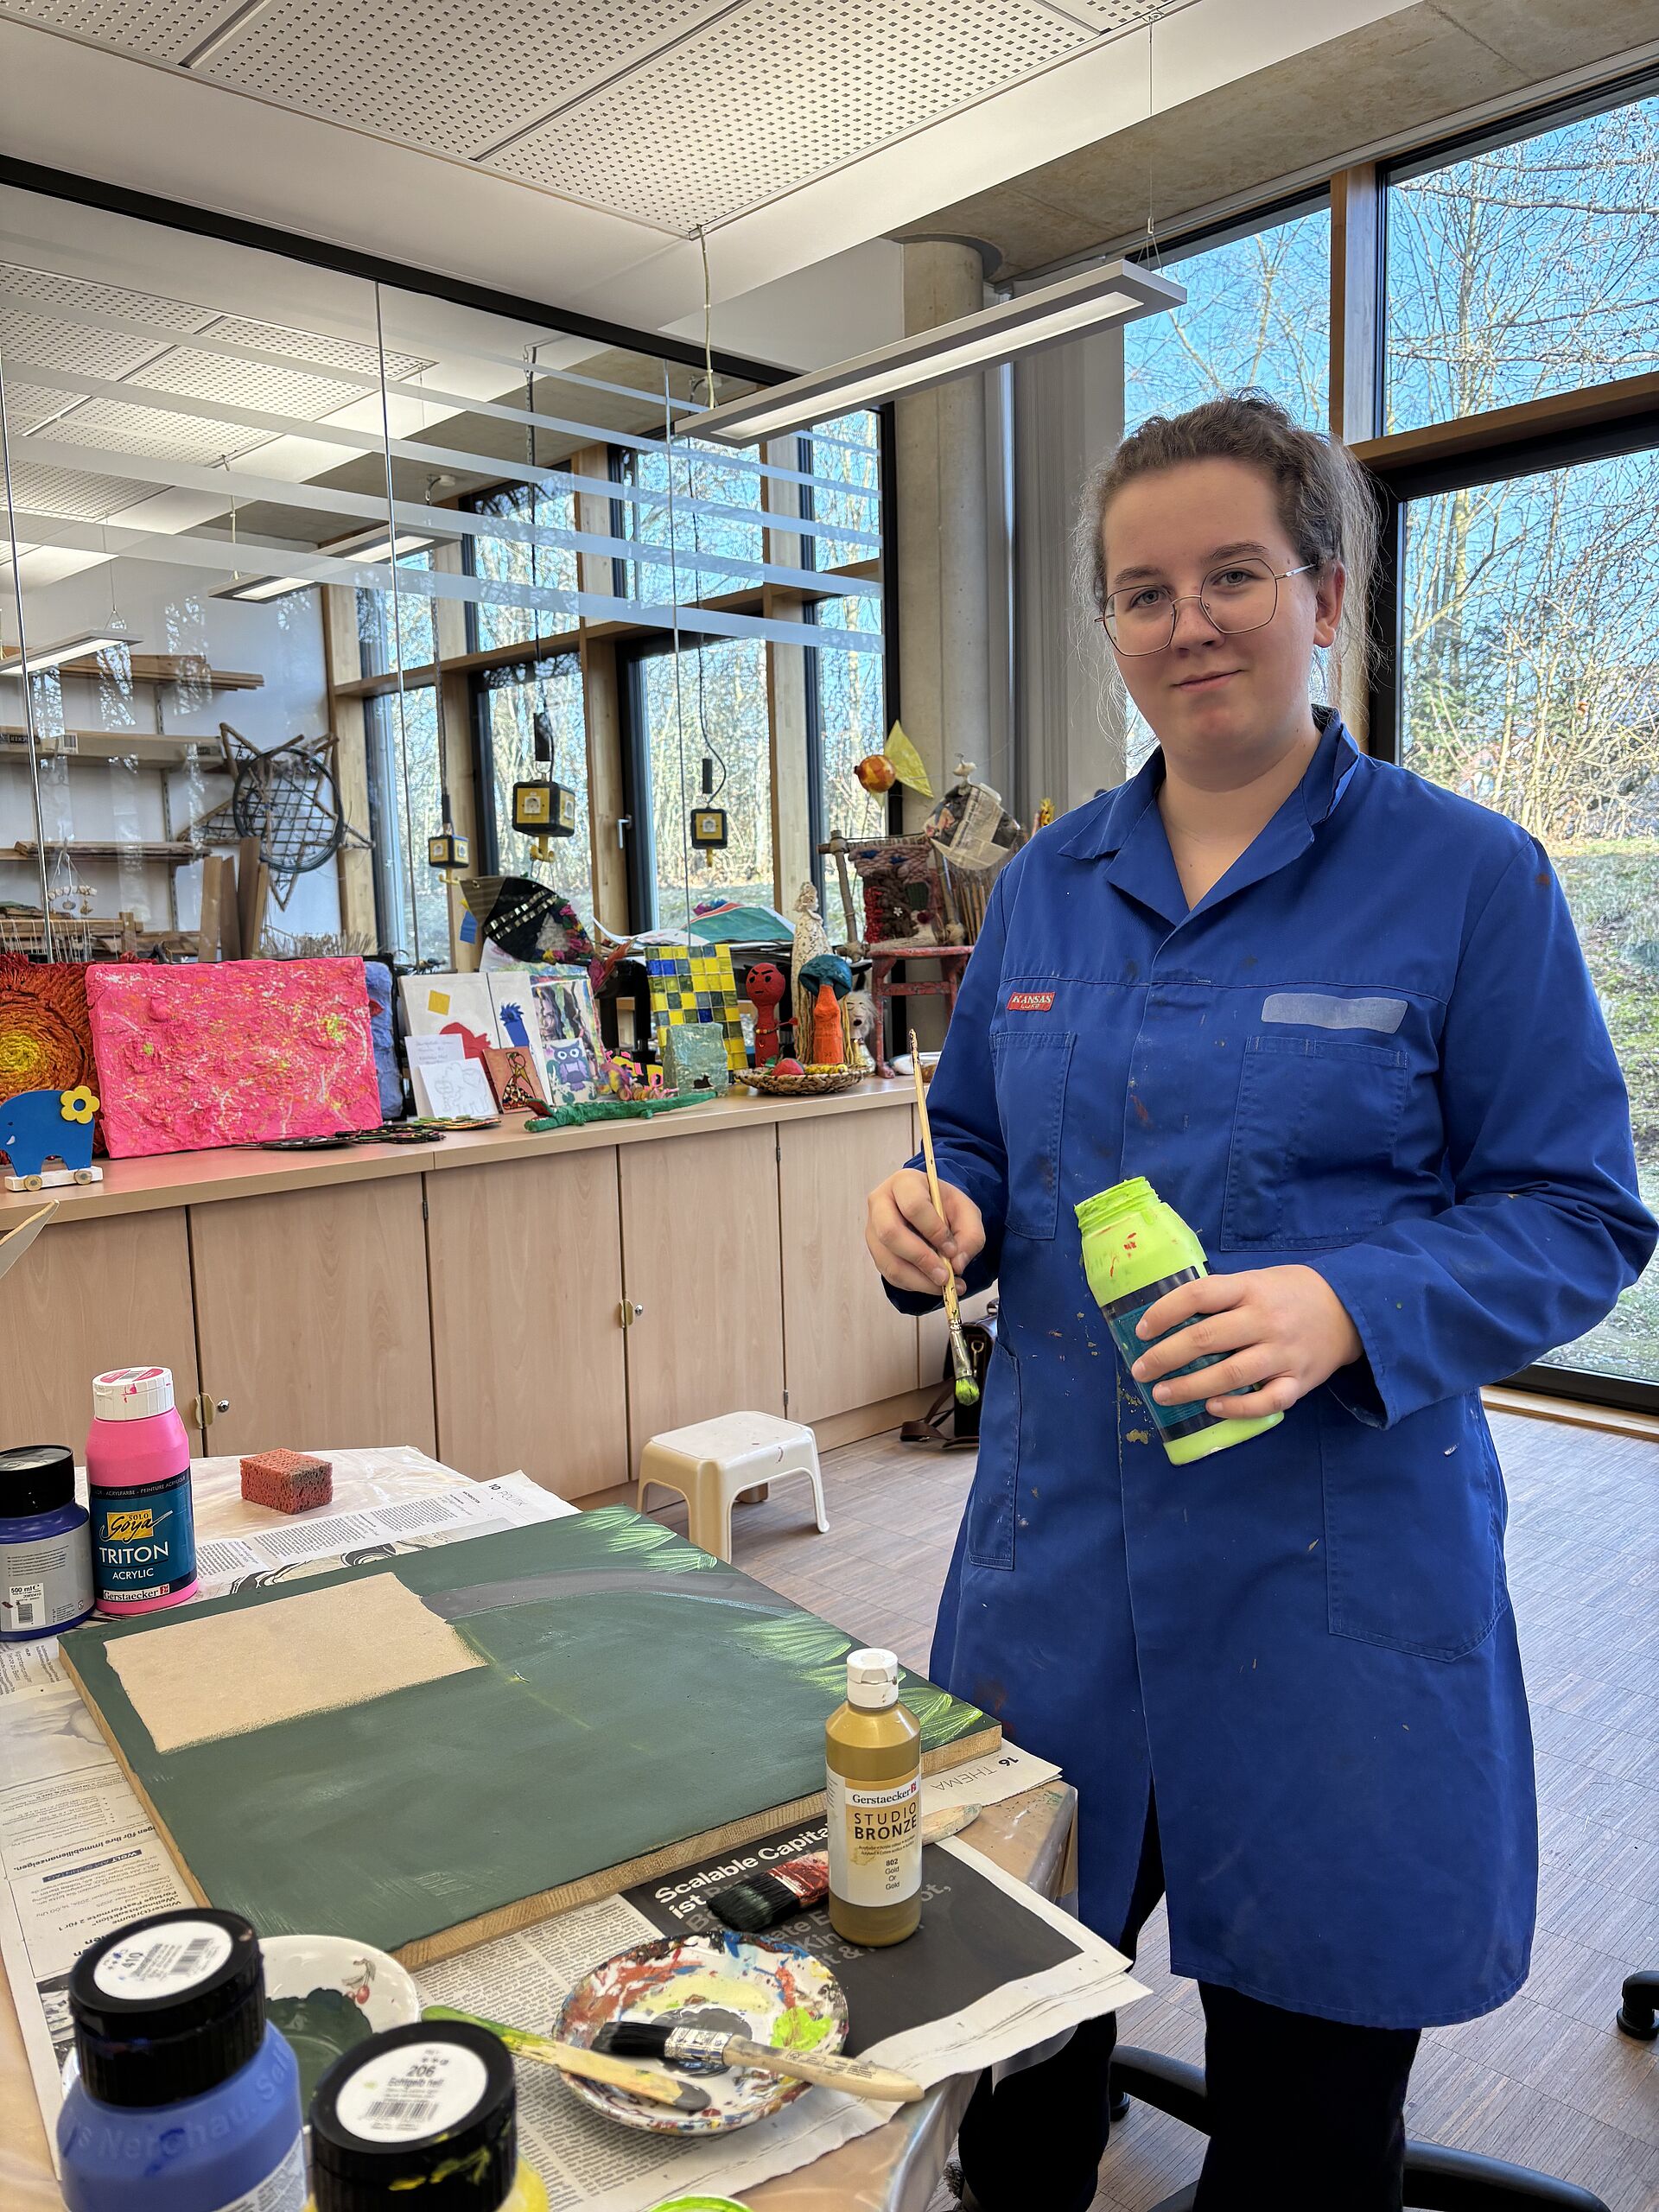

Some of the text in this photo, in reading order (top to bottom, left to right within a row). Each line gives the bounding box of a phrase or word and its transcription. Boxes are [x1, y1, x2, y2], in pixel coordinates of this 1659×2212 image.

[101, 1516, 156, 1544] Goya
[99, 1541, 169, 1564] TRITON
[112, 1568, 154, 1580] ACRYLIC
[104, 1589, 159, 1600] Gerstaecker
[930, 1757, 1019, 1791] 16 THEMA
[852, 1788, 911, 1804] Gerstaecker
[854, 1802, 917, 1826] STUDIO
[855, 1815, 917, 1840] BRONZE
[105, 1836, 122, 1845] Ihre
[13, 1841, 105, 1872] Immobilienanzeigen.
[655, 1857, 759, 1904] Scalable
[758, 1822, 829, 1860] Capita
[886, 1858, 899, 1866] 802
[885, 1866, 899, 1875] Gold
[885, 1881, 899, 1890] Gold
[668, 1893, 707, 1919] ist
[406, 2064, 435, 2077] 206
